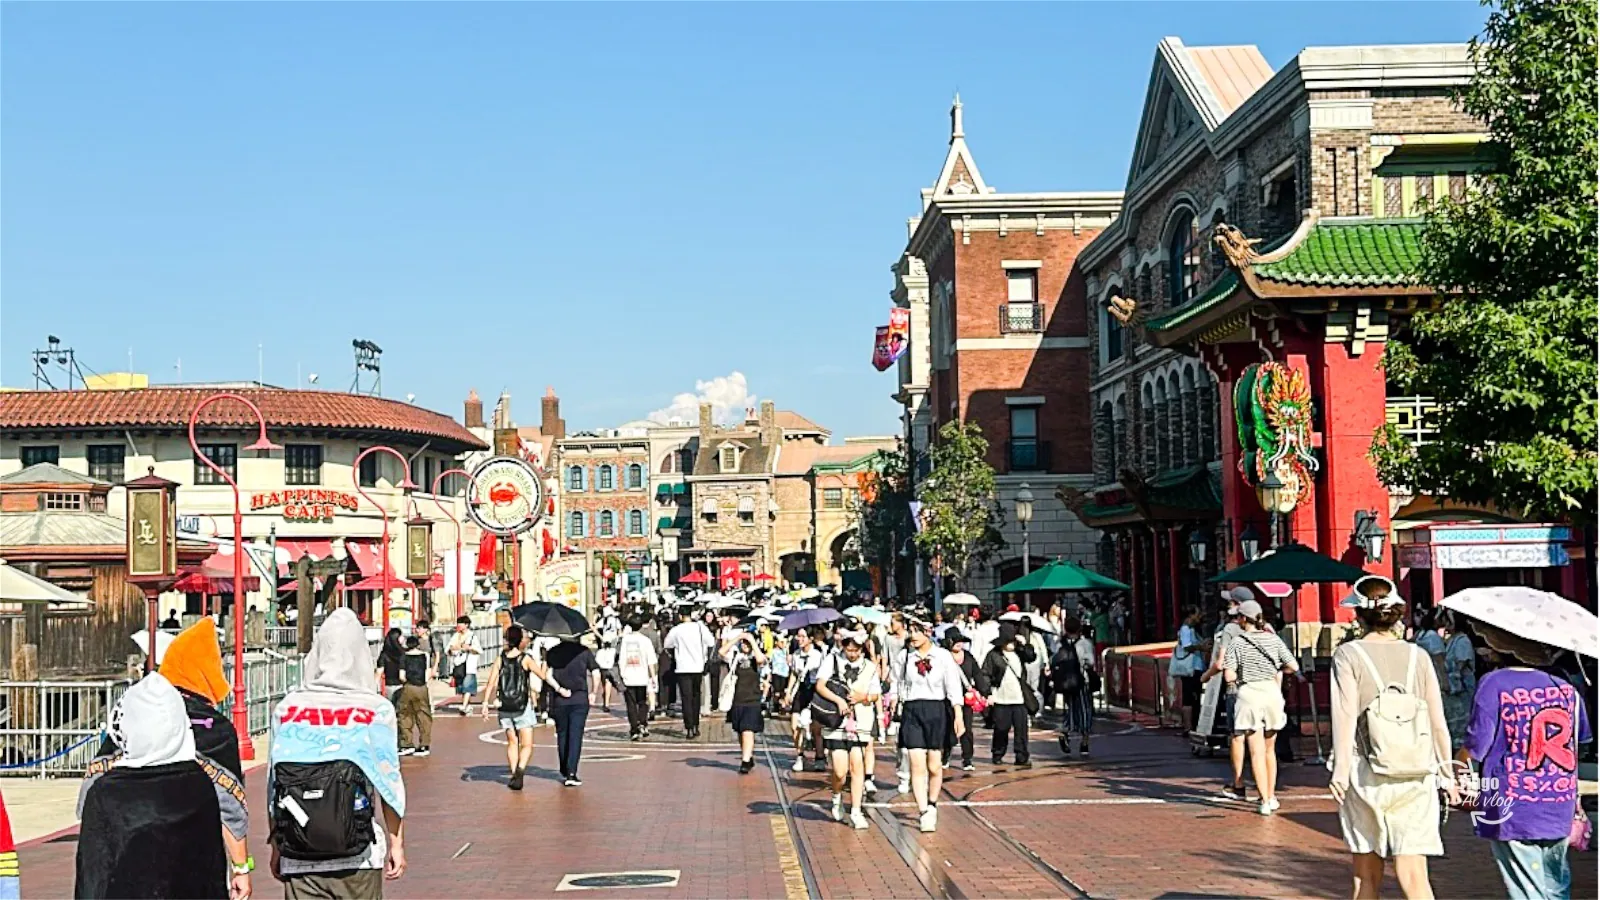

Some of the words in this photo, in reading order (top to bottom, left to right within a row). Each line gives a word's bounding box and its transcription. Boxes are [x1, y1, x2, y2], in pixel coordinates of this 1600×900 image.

[251, 489, 358, 510] HAPPINESS
[284, 505, 335, 519] CAFE
[281, 706, 375, 726] JAWS
[1526, 708, 1576, 772] R
